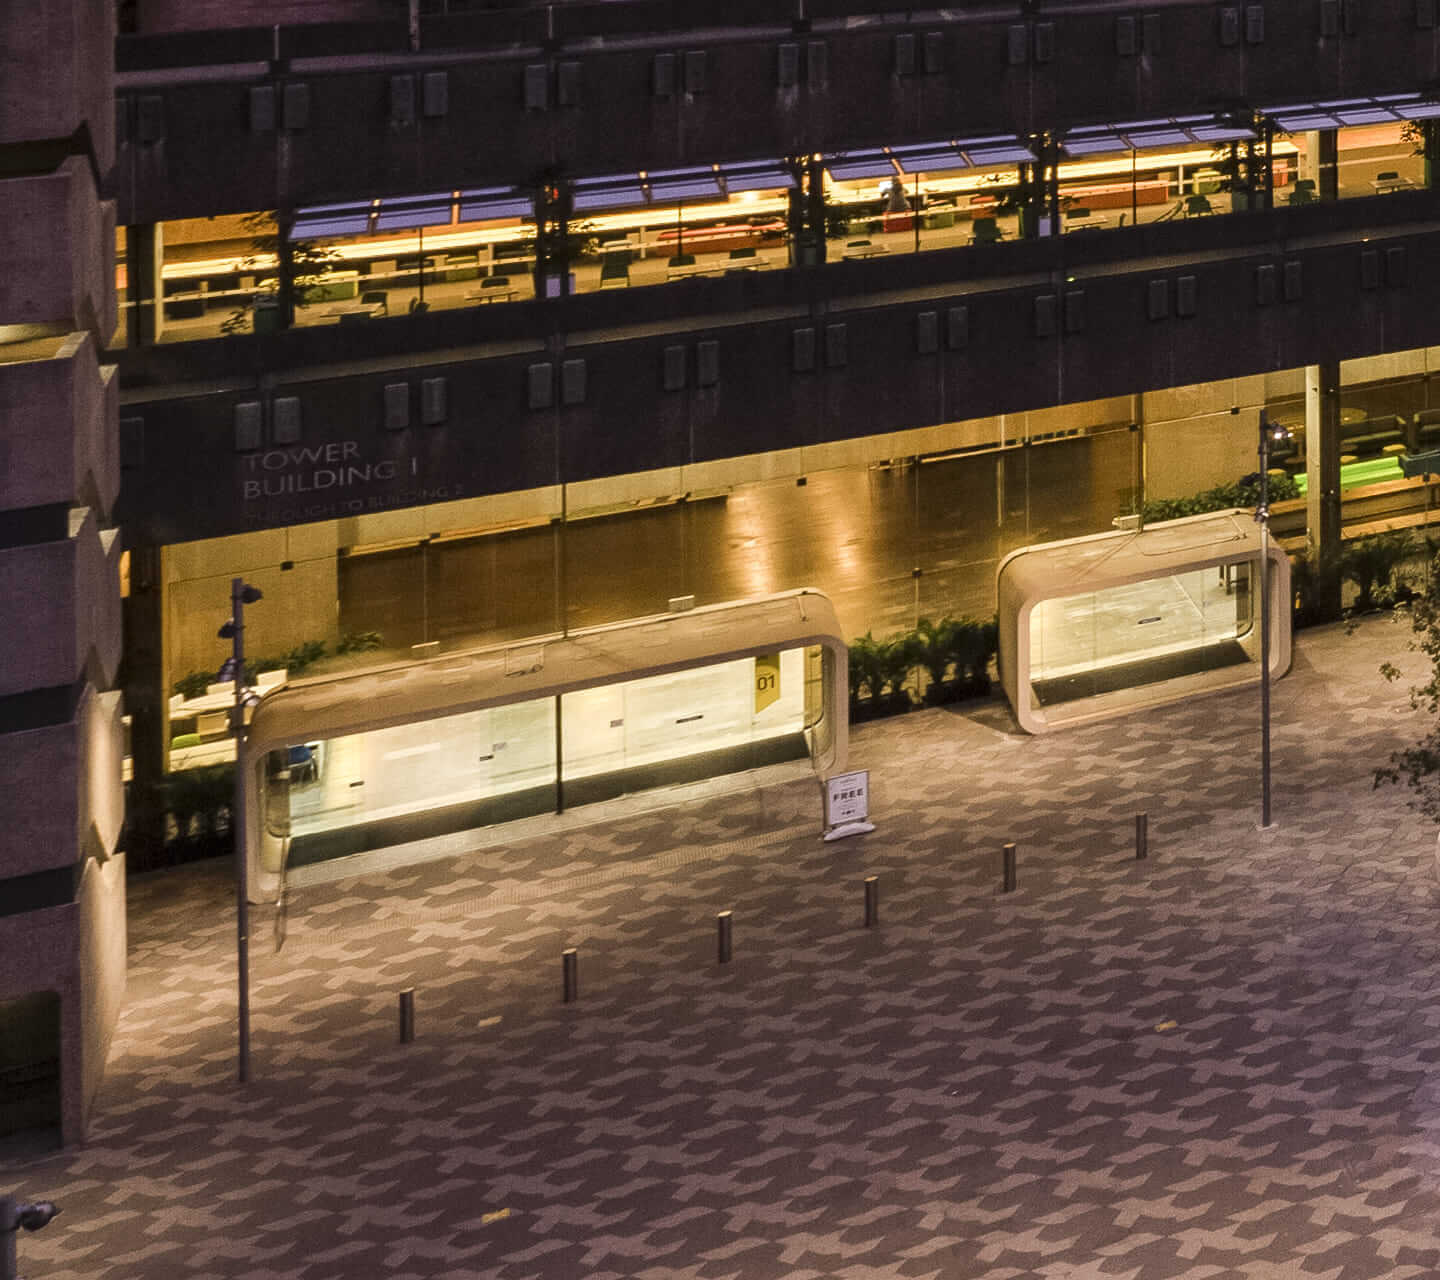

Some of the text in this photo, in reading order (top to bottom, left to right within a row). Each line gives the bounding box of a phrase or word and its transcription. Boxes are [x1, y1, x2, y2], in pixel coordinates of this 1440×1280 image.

[242, 441, 361, 472] TOWER
[243, 460, 398, 499] BUILDING
[757, 675, 775, 691] 01
[833, 788, 864, 801] FREE
